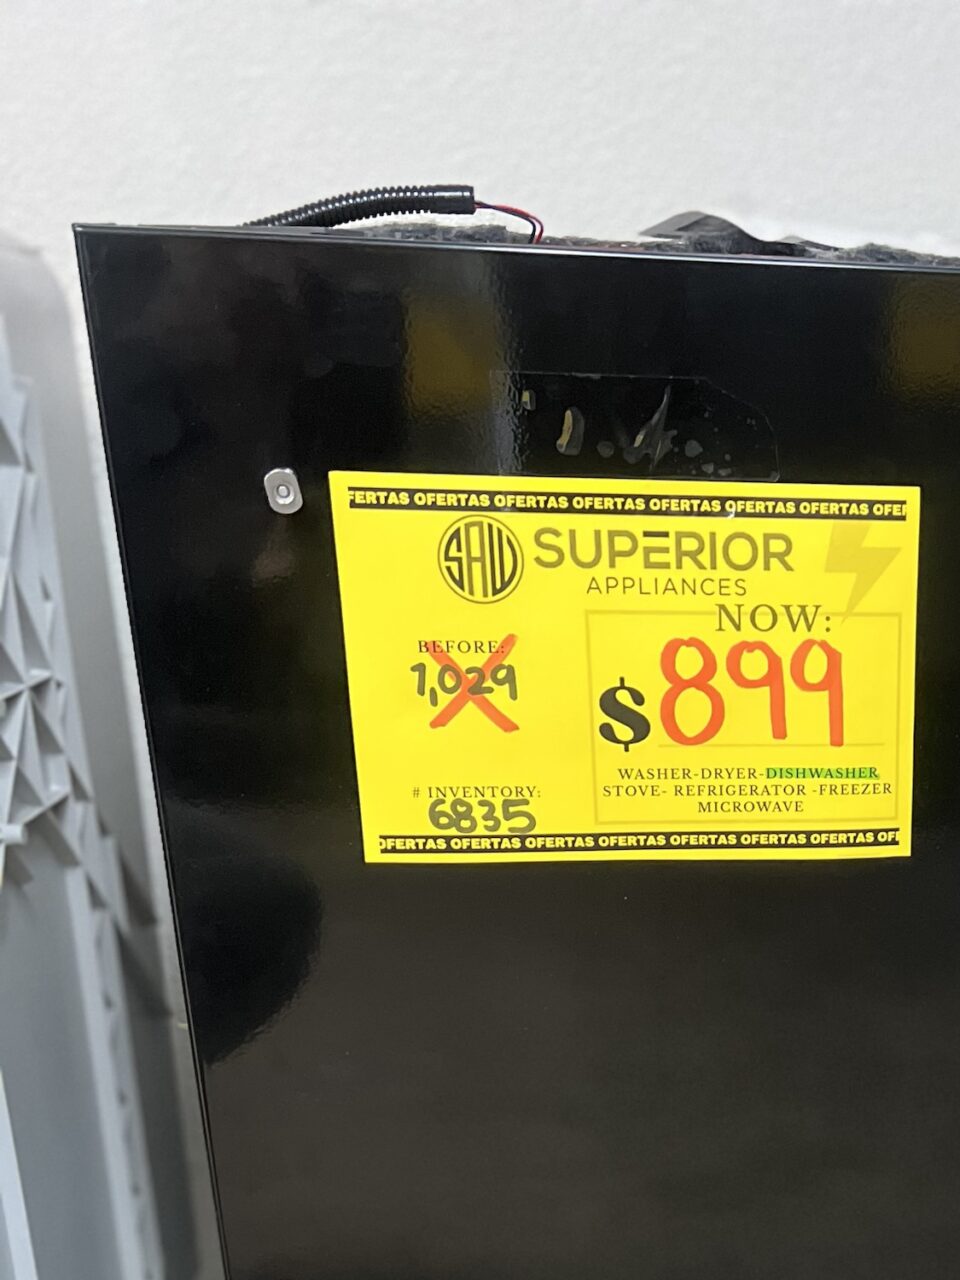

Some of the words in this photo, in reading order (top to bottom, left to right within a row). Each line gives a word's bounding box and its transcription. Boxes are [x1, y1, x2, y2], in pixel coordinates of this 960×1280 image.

[413, 492, 490, 507] OFERTAS
[494, 494, 569, 509] OFERTAS
[572, 496, 646, 511] OFERTAS
[649, 498, 721, 513] OFERTAS
[725, 500, 796, 514] OFERTAS
[799, 501, 869, 516] OFERTAS
[533, 527, 795, 572] SUPERIOR
[586, 576, 747, 597] APPLIANCES
[715, 604, 832, 633] NOW:
[418, 640, 505, 653] BEFORE:
[410, 662, 518, 708] 1,029
[412, 787, 421, 799] #
[427, 786, 542, 799] INVENTORY:
[674, 784, 807, 797] REFRIGERATOR
[428, 798, 537, 834] 6835
[698, 801, 805, 813] MICROWAVE
[450, 837, 522, 850] OFERTAS
[525, 836, 595, 849] OFERTAS
[598, 835, 667, 847] OFERTAS
[669, 834, 737, 846] OFERTAS
[740, 833, 807, 845] OFERTAS
[810, 831, 875, 844] OFERTAS
